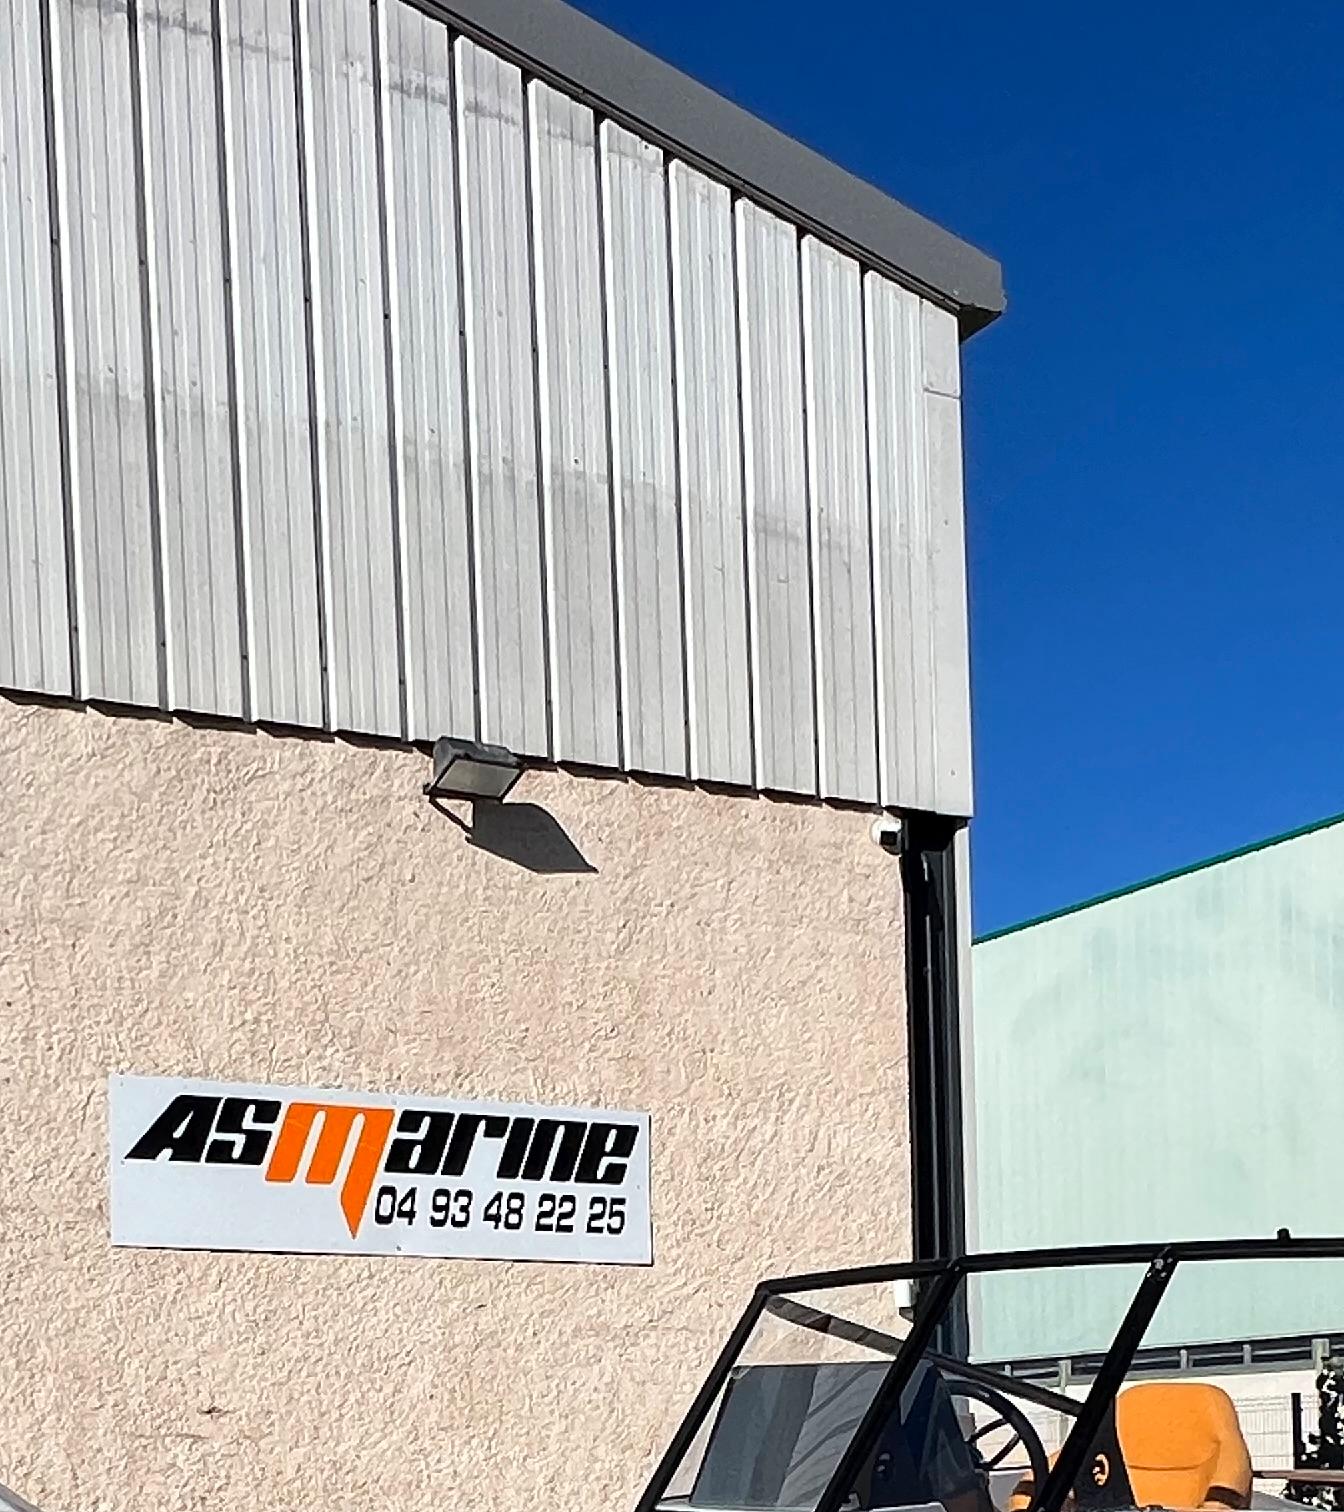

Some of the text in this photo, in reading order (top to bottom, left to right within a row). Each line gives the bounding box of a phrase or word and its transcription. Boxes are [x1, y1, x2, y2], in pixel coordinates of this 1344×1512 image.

[374, 1185, 626, 1236] 04 93 48 22 25
